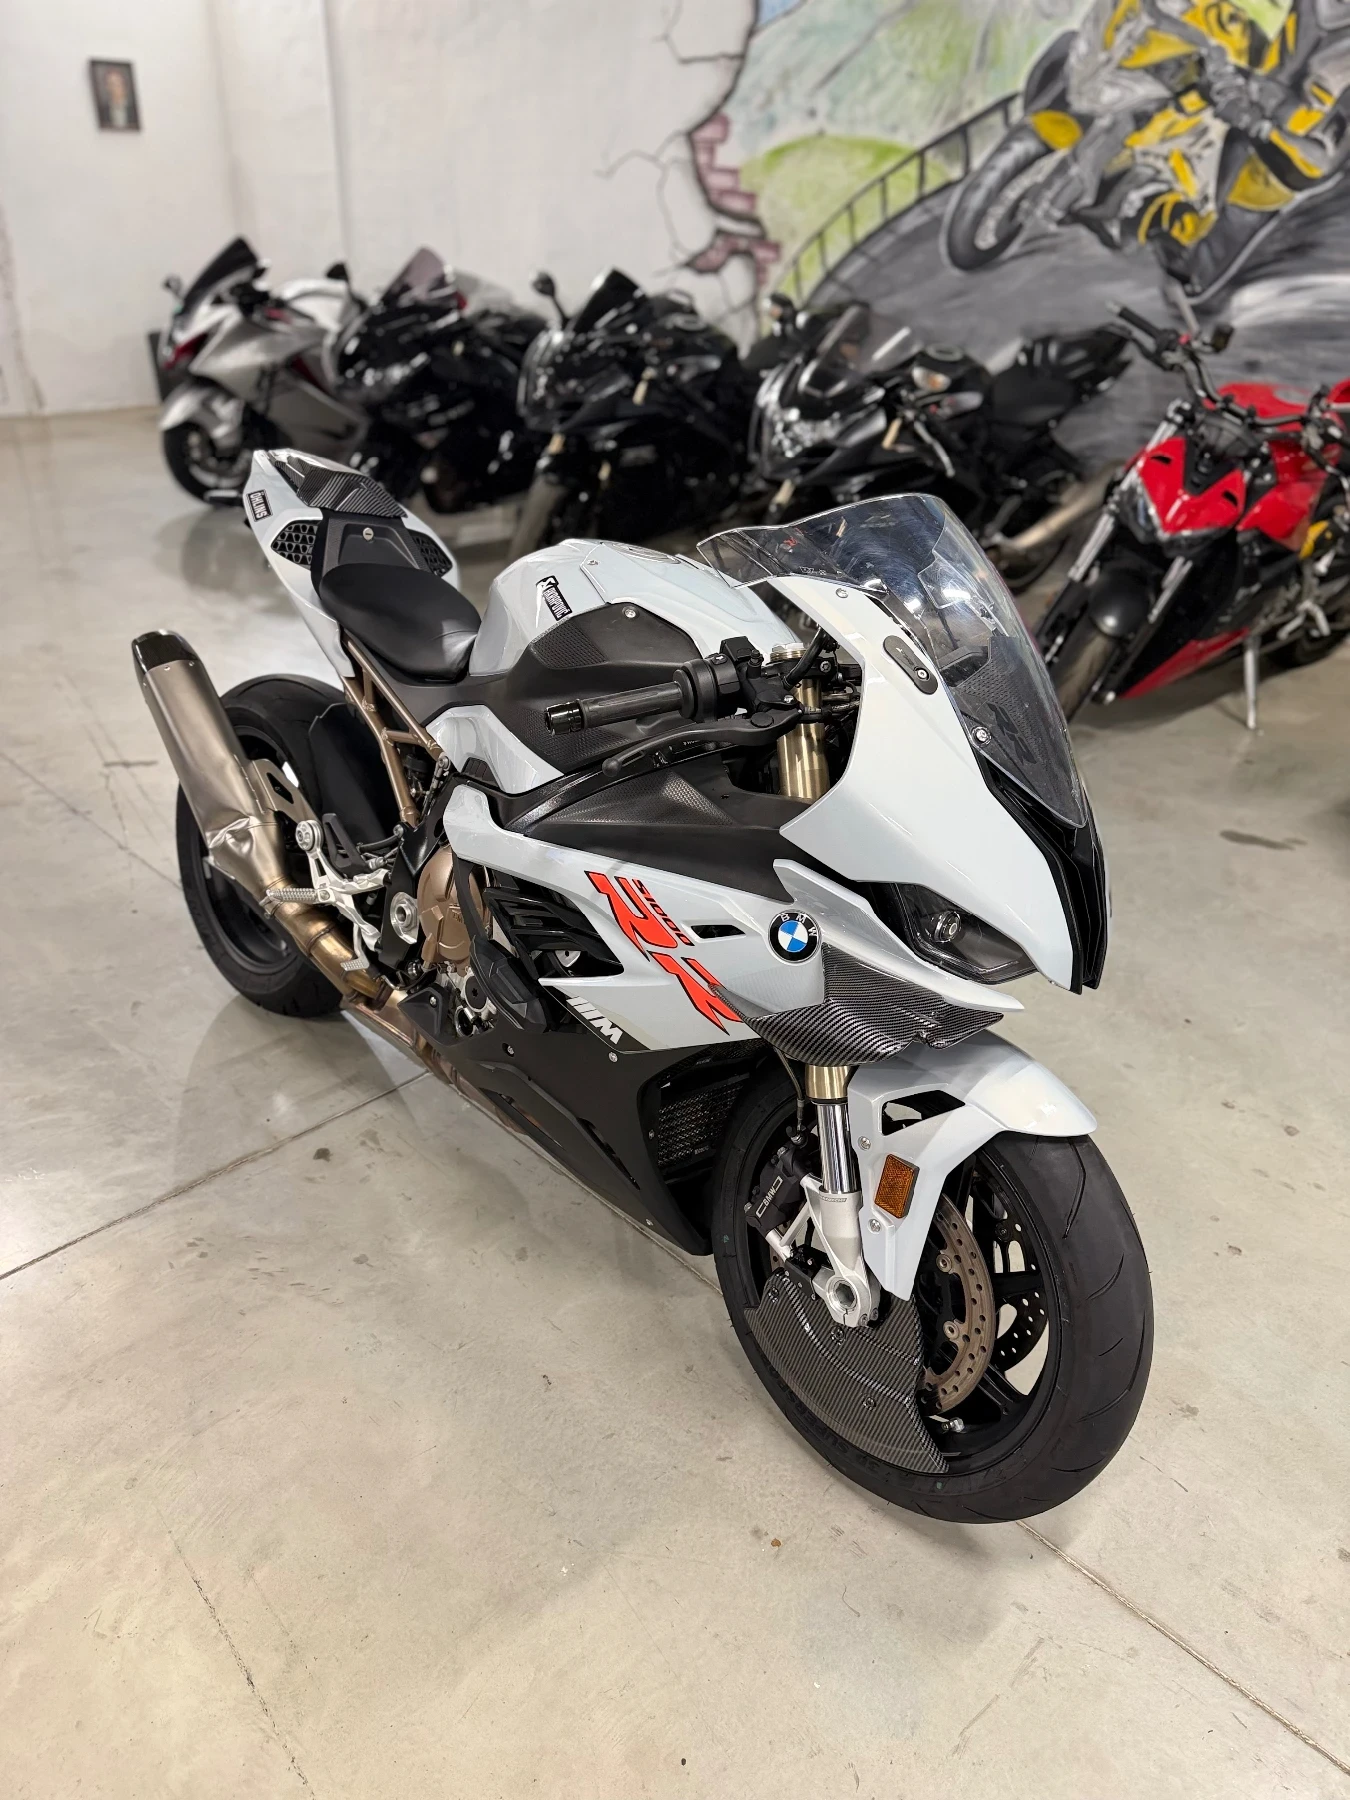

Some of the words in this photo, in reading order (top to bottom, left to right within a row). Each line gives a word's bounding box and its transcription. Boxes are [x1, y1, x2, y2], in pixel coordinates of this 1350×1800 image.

[632, 879, 695, 946] S1000
[780, 911, 818, 937] BMW
[763, 1186, 776, 1207] BMW
